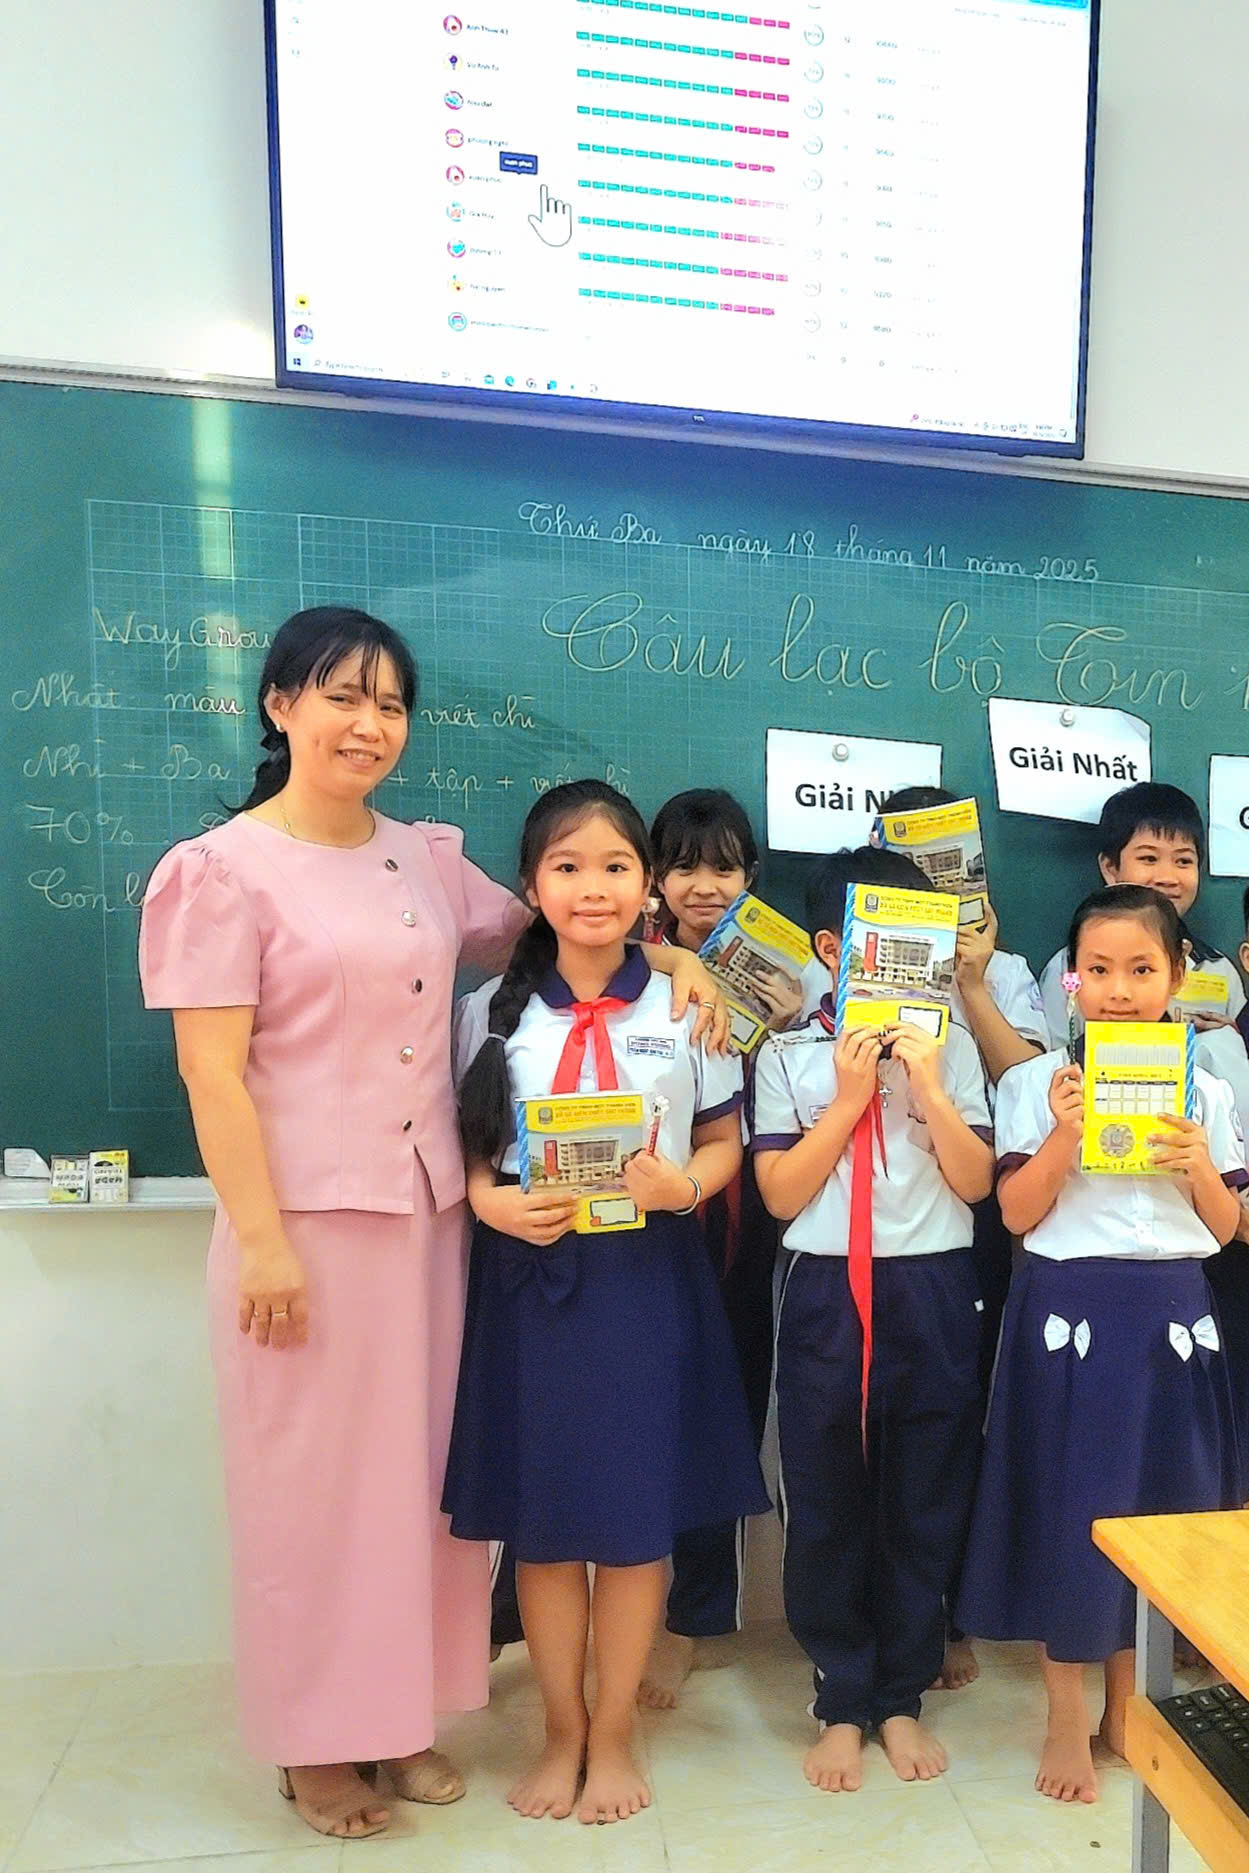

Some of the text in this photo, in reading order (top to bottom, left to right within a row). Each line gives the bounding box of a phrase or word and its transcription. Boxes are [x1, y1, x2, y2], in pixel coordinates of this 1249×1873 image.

[518, 501, 1099, 582] Thứ Ba ngày 18 tháng 11 năm 2025
[92, 607, 272, 671] Way Grou
[542, 591, 745, 681] Câu
[770, 593, 893, 696] lạc
[1036, 621, 1201, 711] Tin
[421, 694, 480, 727] viết
[493, 695, 536, 728] chì
[160, 744, 231, 780] Ba
[425, 767, 483, 809] tập
[606, 763, 631, 796] hì
[1009, 745, 1138, 782] Giải Nhất
[795, 782, 853, 811] Giải
[25, 803, 134, 845] 70%
